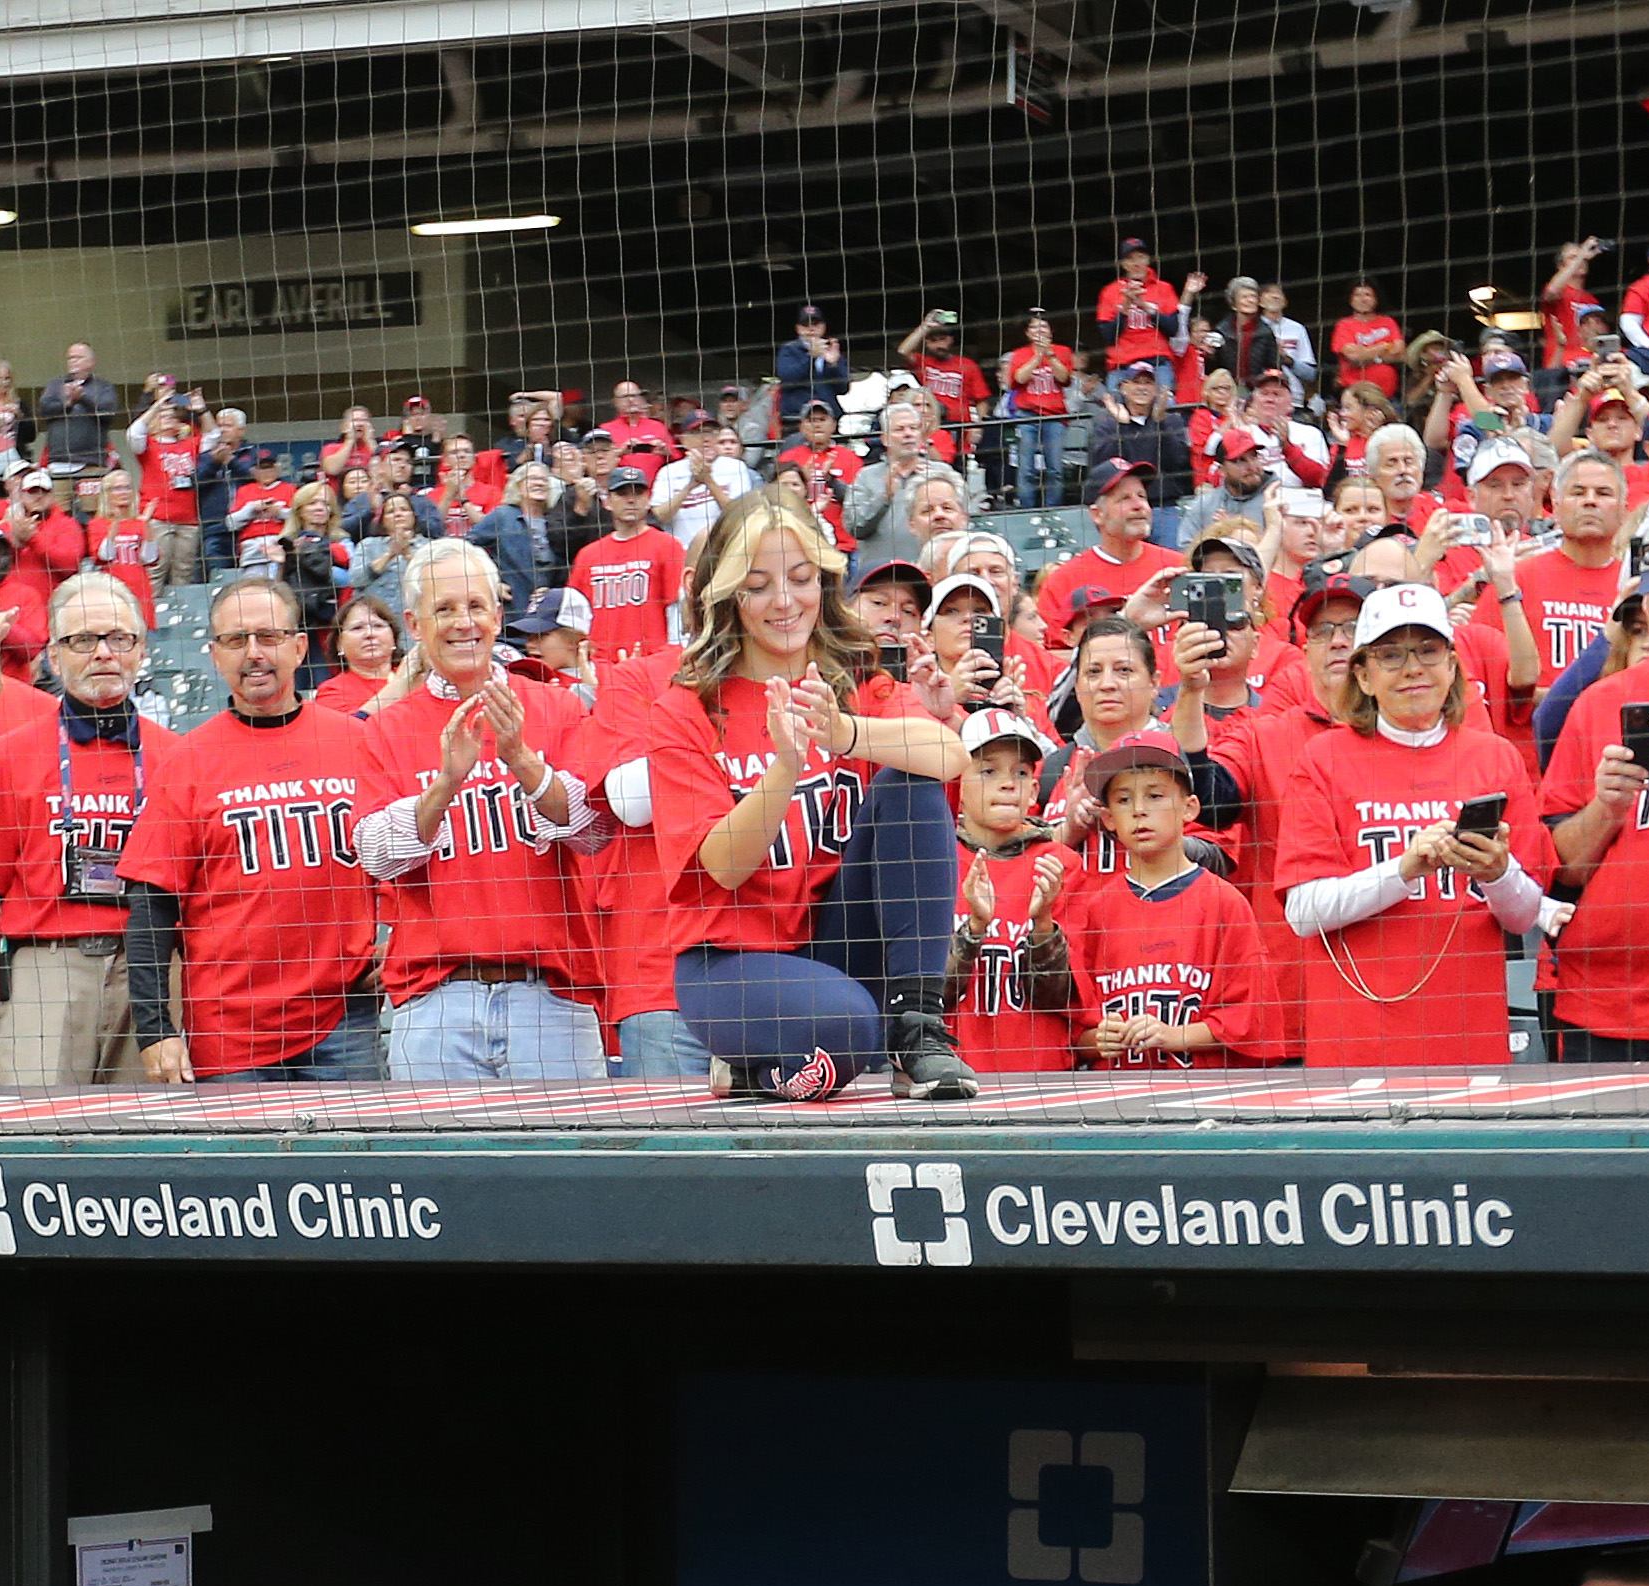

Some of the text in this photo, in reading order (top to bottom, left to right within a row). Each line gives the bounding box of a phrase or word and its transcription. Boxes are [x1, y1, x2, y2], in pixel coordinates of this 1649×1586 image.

[187, 288, 262, 331] EARL
[1397, 589, 1416, 608] C
[1542, 601, 1603, 620] THANK
[45, 794, 130, 816] THANK
[217, 777, 357, 806] THANK YOU
[1355, 800, 1450, 821] THANK
[1096, 965, 1174, 994] THANK
[23, 1180, 443, 1242] Cleveland Clinic
[985, 1181, 1516, 1249] Cleveland Clinic
